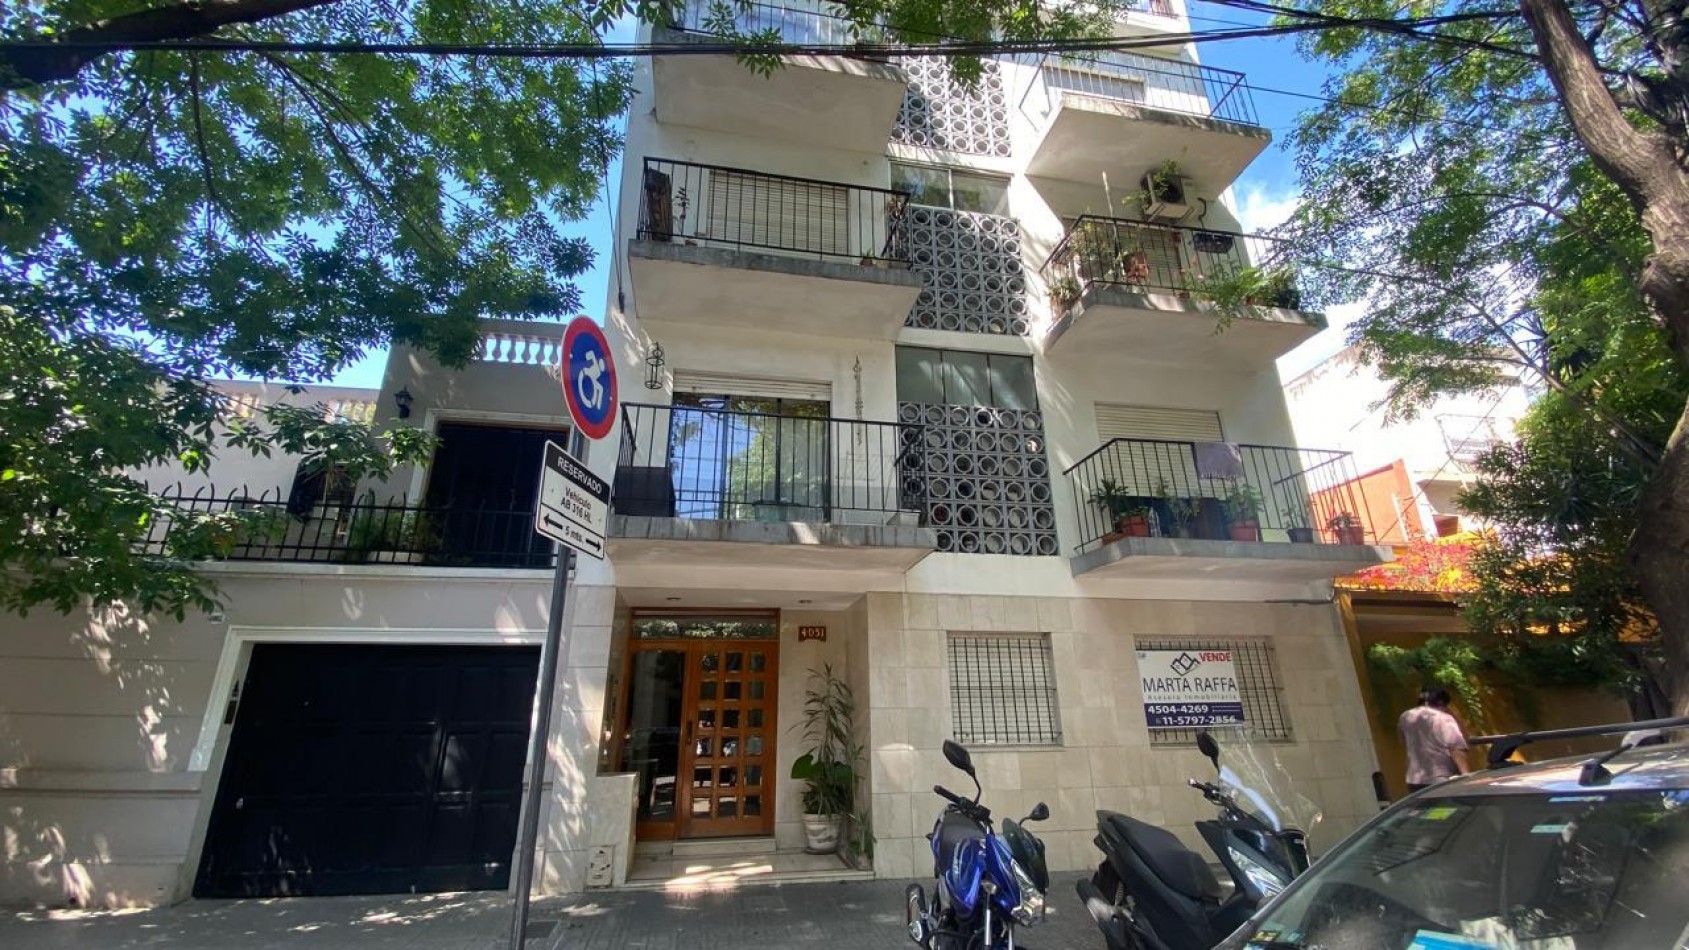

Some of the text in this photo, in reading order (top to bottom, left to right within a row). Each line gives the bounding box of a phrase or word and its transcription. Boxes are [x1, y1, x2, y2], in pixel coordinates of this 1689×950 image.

[557, 456, 603, 495] RESERVADO
[560, 496, 571, 510] AB
[565, 525, 570, 536] 5
[1199, 652, 1231, 662] VENDE
[1143, 677, 1237, 693] MARTA RAFFA
[1147, 704, 1209, 715] 4504-4269
[1162, 715, 1236, 725] 11-5797-2856
